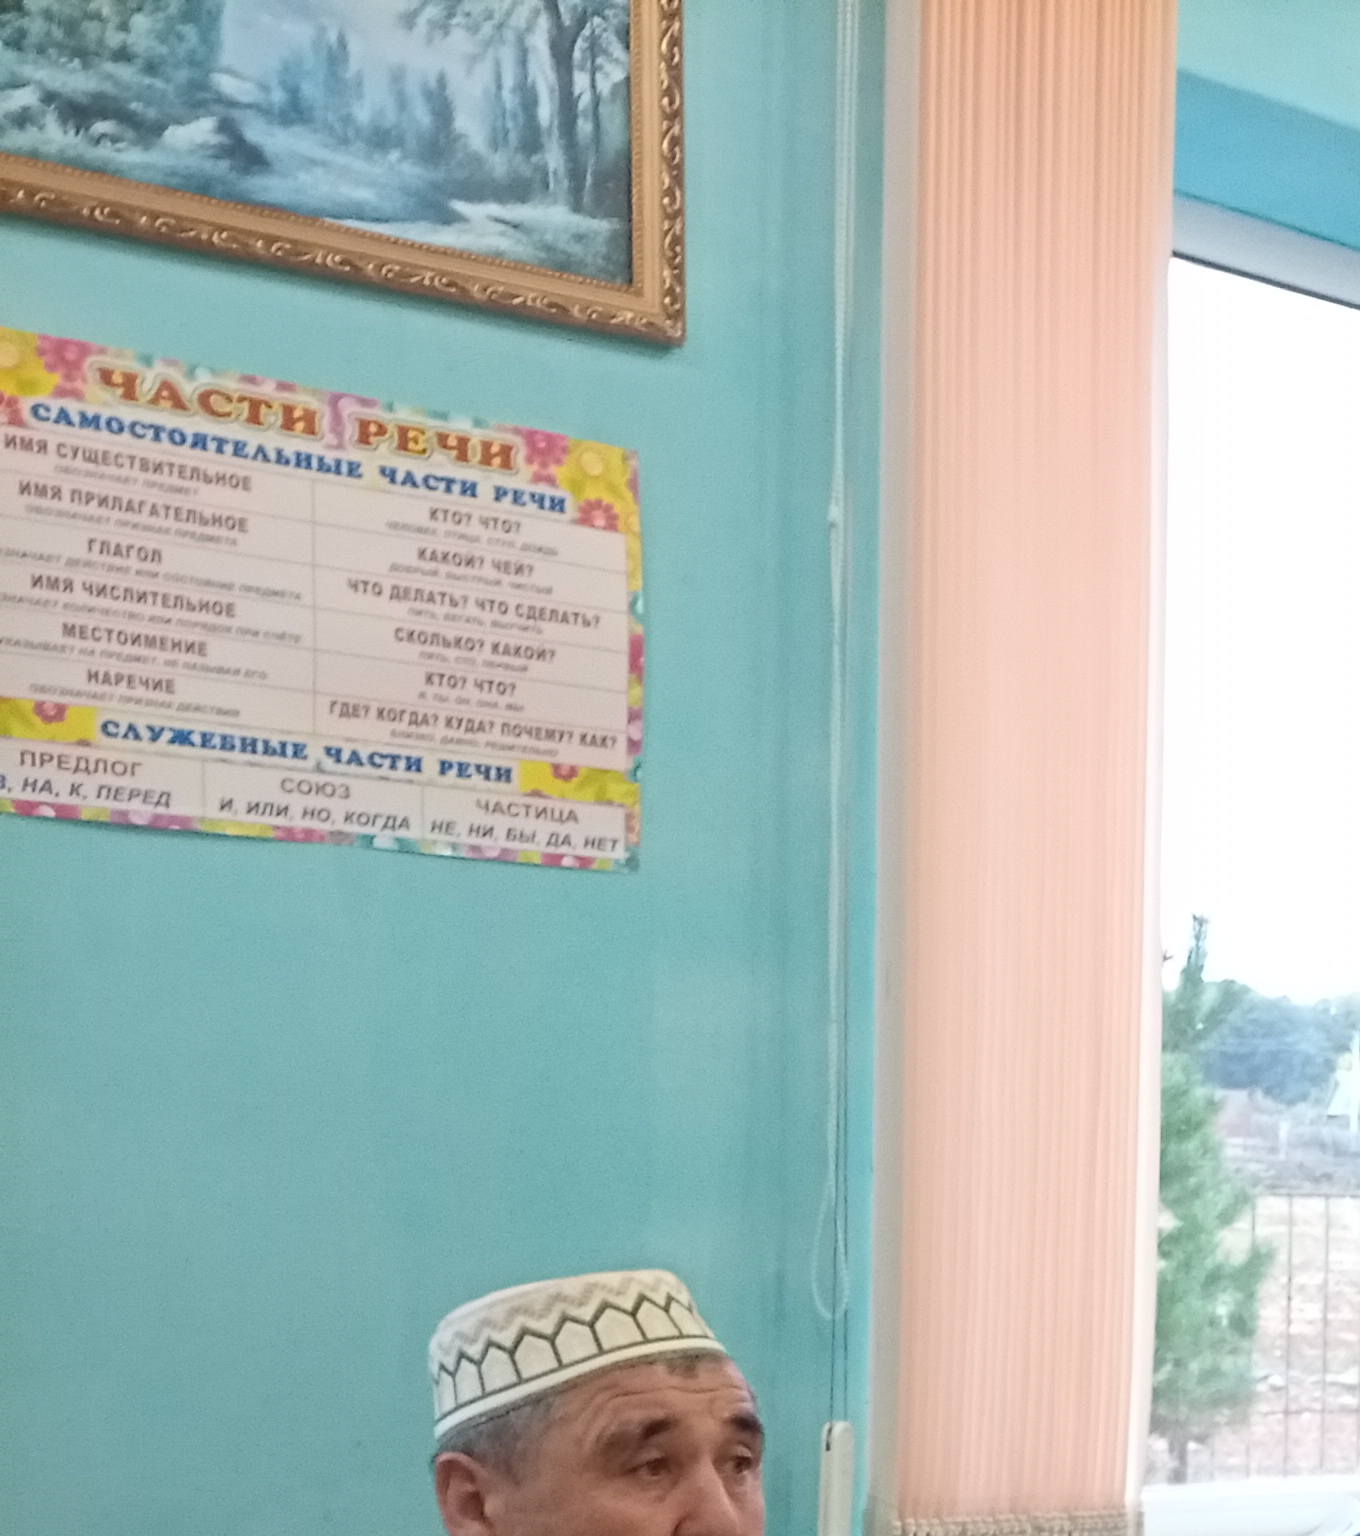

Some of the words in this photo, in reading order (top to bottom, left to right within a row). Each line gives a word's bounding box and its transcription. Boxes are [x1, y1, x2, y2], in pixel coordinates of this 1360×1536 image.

[98, 366, 320, 436] ЧАСТИ
[355, 416, 515, 470] РЕЧИ
[4, 433, 48, 455] ИМЯ
[56, 442, 253, 492] СУЩЕСТВИТЕЛЬНОЕ
[31, 403, 363, 478] САМОСТОЯТЕЛЬНЫЕ
[380, 465, 479, 498] ЧАСТИ
[494, 485, 567, 514] РЕЧИ
[18, 479, 62, 501] ИМЯ
[69, 488, 250, 534] ПРИЛАГАТЕЛЬНОЕ
[428, 506, 473, 527] КТО?
[478, 515, 522, 536] ЧТО?
[86, 537, 163, 565] ГЛАГОЛ
[417, 546, 486, 571] КАКОЙ?
[490, 557, 535, 578] ЧЕЙ?
[30, 573, 74, 595] ИМЯ
[81, 580, 237, 619] ЧИСЛИТЕЛЬНОЕ
[347, 578, 384, 598] ЧТО
[389, 584, 469, 610] ДЕЛАТЬ?
[475, 596, 510, 616] ЧТО
[515, 603, 602, 630] СДЕЛАТЬ?
[62, 622, 208, 657] МЕСТОИМЕНИЕ
[394, 627, 486, 653] СКОЛЬКО?
[490, 640, 557, 664] КАКОЙ?
[86, 668, 175, 696] НАРЕЧИЕ
[425, 671, 468, 691] КТО?
[473, 678, 517, 698] ЧТО?
[329, 699, 371, 719] ГДЕ?
[376, 706, 440, 728] КОГДА?
[444, 715, 496, 736] КУДА?
[501, 722, 575, 745] ПОЧЕМУ?
[578, 732, 619, 750] КАК?
[19, 750, 143, 777] ПРЕДЛОГ
[100, 720, 309, 760] СЛУЖЕБНЫЕ
[323, 745, 424, 774] ЧАСТИ
[438, 759, 514, 785] РЕЧИ
[21, 778, 60, 799] НА,
[96, 784, 172, 809] ПЕРЕД
[280, 776, 351, 800] СОЮЗ
[343, 811, 411, 832] КОГДА
[476, 798, 580, 824] ЧАСТИЦА
[583, 836, 620, 852] НЕТ
